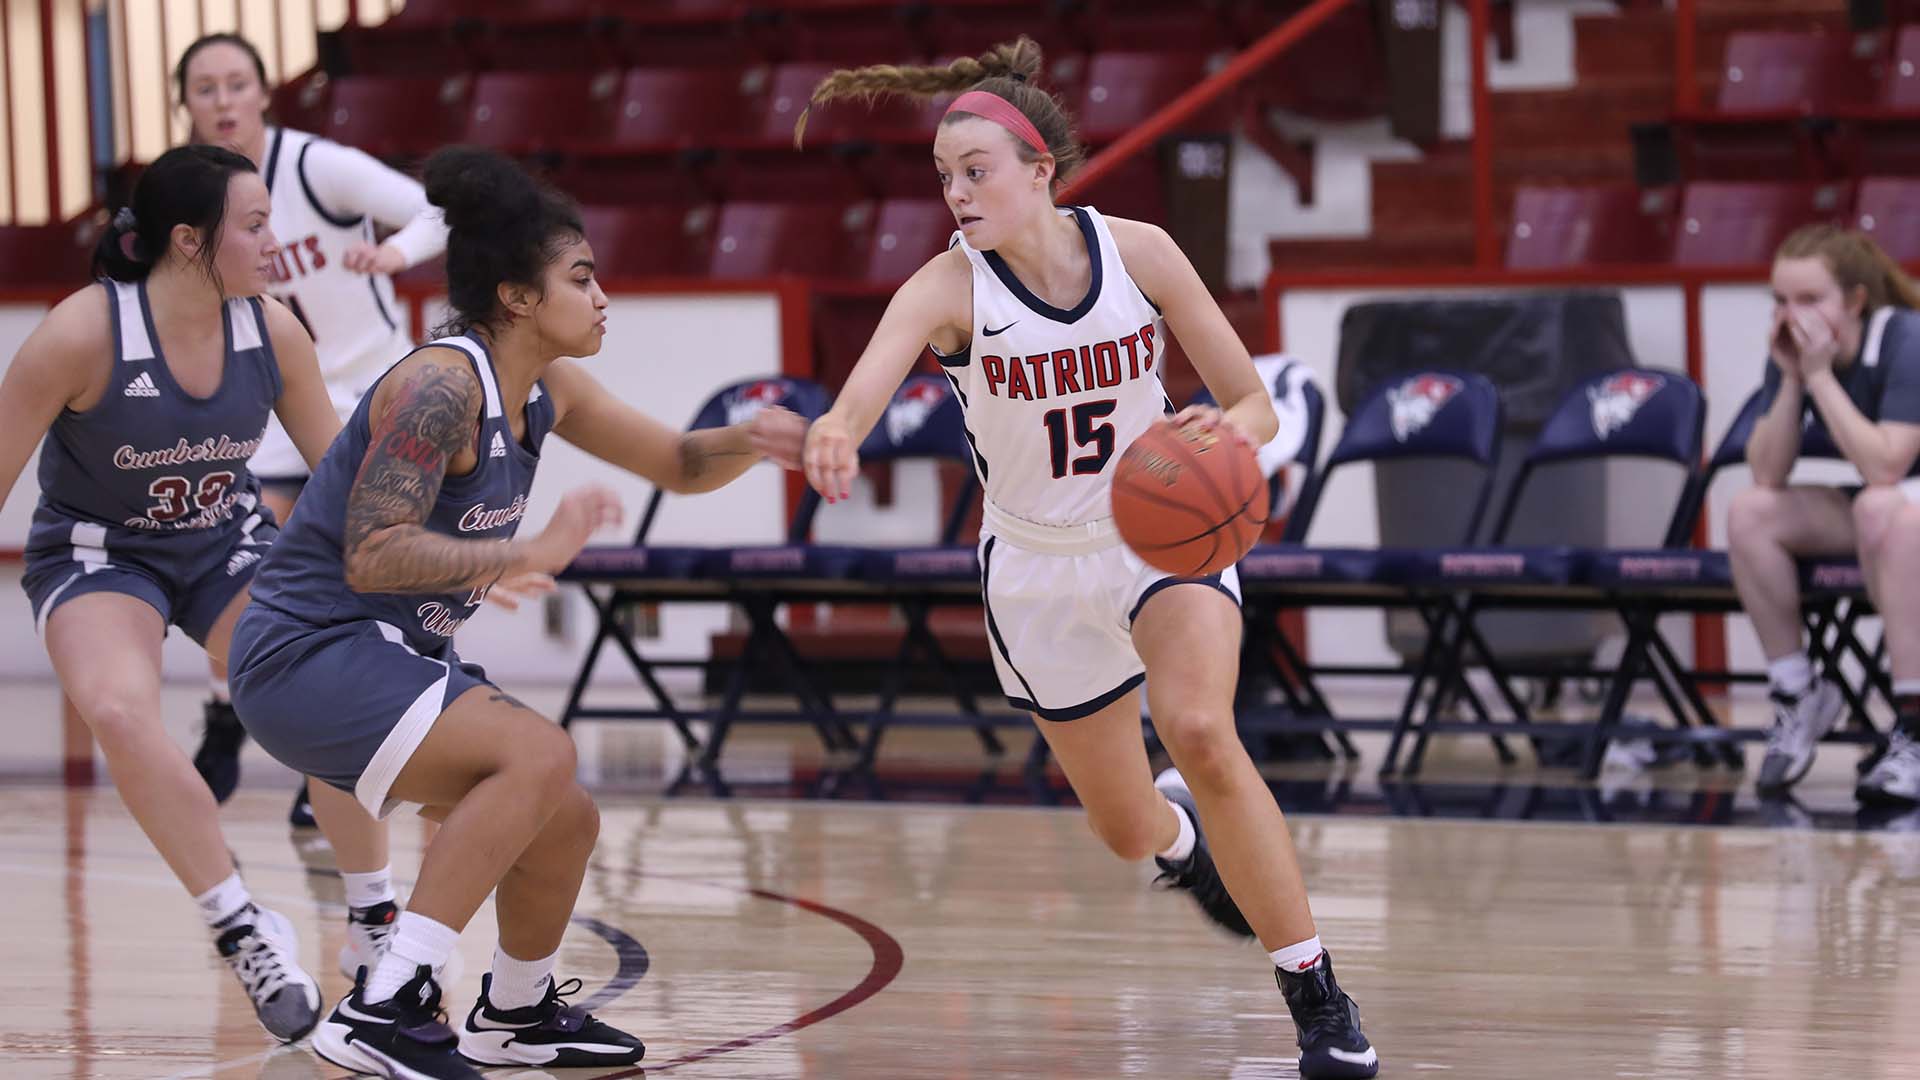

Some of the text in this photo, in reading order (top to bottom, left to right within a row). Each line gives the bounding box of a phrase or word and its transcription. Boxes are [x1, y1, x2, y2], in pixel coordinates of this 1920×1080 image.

[124, 387, 161, 398] adidas
[981, 322, 1156, 401] PATRIOTS
[1043, 398, 1118, 480] 15
